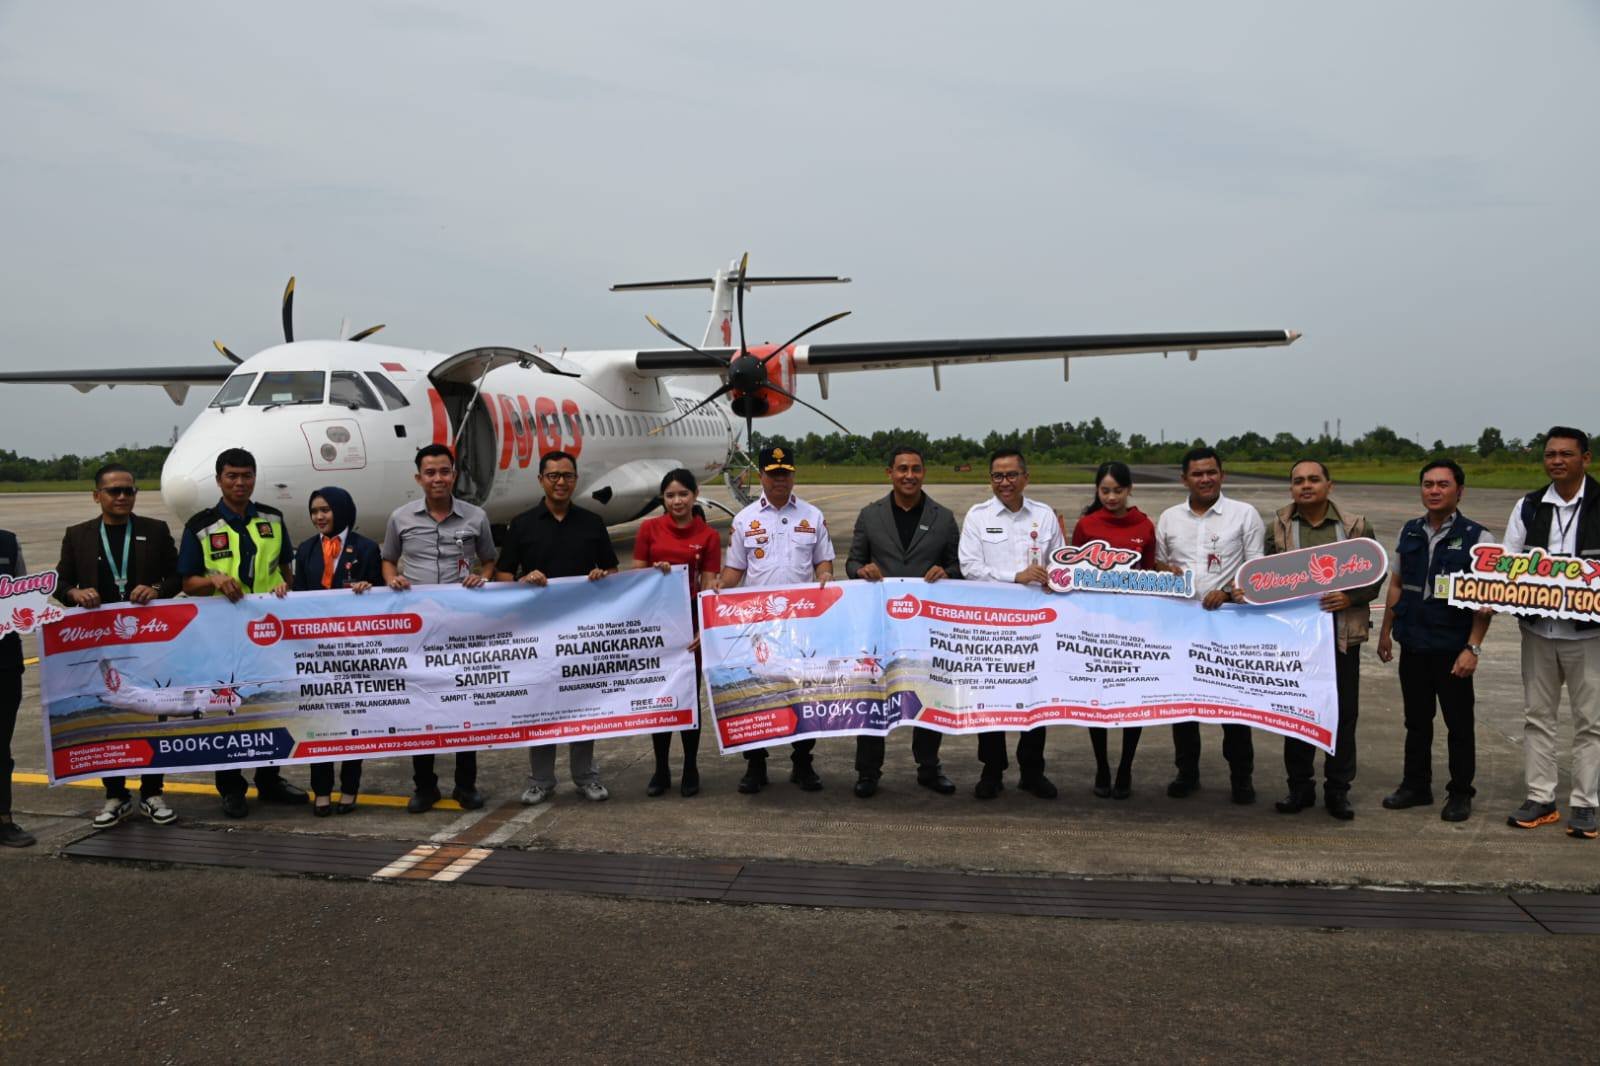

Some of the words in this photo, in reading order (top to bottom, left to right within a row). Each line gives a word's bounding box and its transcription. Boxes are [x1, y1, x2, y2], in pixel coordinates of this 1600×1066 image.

[1054, 542, 1133, 569] Ayo
[1473, 546, 1582, 579] Explore
[1073, 567, 1192, 595] PALANGKARAYA!
[1249, 570, 1308, 592] Wings
[1339, 554, 1373, 577] Air
[1454, 577, 1563, 610] KALIMANTAN
[37, 605, 61, 623] Air
[716, 602, 763, 618] Wings
[788, 598, 816, 610] Air
[928, 605, 982, 621] TERBANG
[984, 611, 1047, 623] LANGSUNG
[59, 626, 111, 643] Wings
[140, 618, 169, 633] Air
[254, 630, 276, 638] BARU
[290, 622, 345, 635] TERBANG
[348, 618, 412, 632] LANGSUNG
[928, 628, 948, 638] Setiap
[1081, 630, 1100, 638] Mulai
[423, 644, 444, 652] Setiap
[512, 636, 539, 644] MINGGU
[448, 635, 468, 643] Mulai
[558, 633, 578, 641] Setiap
[1056, 632, 1076, 640] Setiap
[382, 646, 409, 654] MINGGU
[555, 635, 665, 657] PALANGKARAYA
[930, 636, 1039, 655] PALANGKARAYA
[1056, 640, 1171, 660] PALANGKARAYA
[1192, 642, 1212, 651] Setiap
[1211, 641, 1229, 650] Mulai
[425, 646, 538, 668] PALANGKARAYA
[932, 656, 983, 672] MUARA
[986, 660, 1036, 673] TEWEH
[1188, 648, 1304, 673] PALANGKARAYA
[296, 656, 408, 675] PALANGKARAYA
[562, 656, 661, 678] BANJARMASIN
[1084, 662, 1141, 674] SAMPIT
[455, 670, 511, 688] SAMPIT
[558, 681, 608, 692] BANJARMASIN
[613, 675, 666, 686] PALANGKARAYA
[929, 673, 953, 685] MUARA
[984, 676, 1038, 685] PALANGKARAYA
[1102, 676, 1160, 684] PALANGKARAYA
[1192, 676, 1245, 690] BANJARMASIN
[1195, 664, 1300, 688] BANJARMASIN
[300, 681, 354, 697] MUARA
[356, 678, 406, 694] TEWEH
[440, 693, 468, 702] SAMPIT
[473, 689, 528, 700] PALANGKARAYA
[299, 702, 325, 711] MUARA
[326, 702, 350, 710] TEWEH
[356, 698, 411, 708] PALANGKARAYA
[630, 698, 654, 707] FREE
[656, 696, 673, 704] 7KG
[1270, 703, 1296, 712] FREE
[1298, 708, 1316, 716] 7KG
[933, 714, 968, 726] TERBANG
[970, 716, 1002, 724] DENGAN
[1070, 709, 1150, 720] www.lionair.co.id
[1159, 707, 1196, 717] Hubungi
[1198, 707, 1216, 716] Biro
[1218, 708, 1263, 721] Perjalanan
[1264, 714, 1298, 730] terdekat
[1300, 725, 1320, 737] Anda
[528, 728, 563, 738] Hubungi
[564, 725, 580, 734] Biro
[581, 720, 623, 733] Perjalanan
[624, 718, 657, 727] terdekat
[658, 715, 678, 723] Anda
[752, 722, 772, 730] Online
[159, 732, 274, 753] BOOKCABIN
[445, 731, 520, 745] www.lionair.co.id
[70, 746, 104, 757] Penjualan
[308, 744, 343, 754] TERBANG
[344, 743, 377, 752] DENGAN
[70, 754, 102, 762] Check-in
[71, 762, 91, 770] Lebih
[92, 758, 116, 766] Mudah
